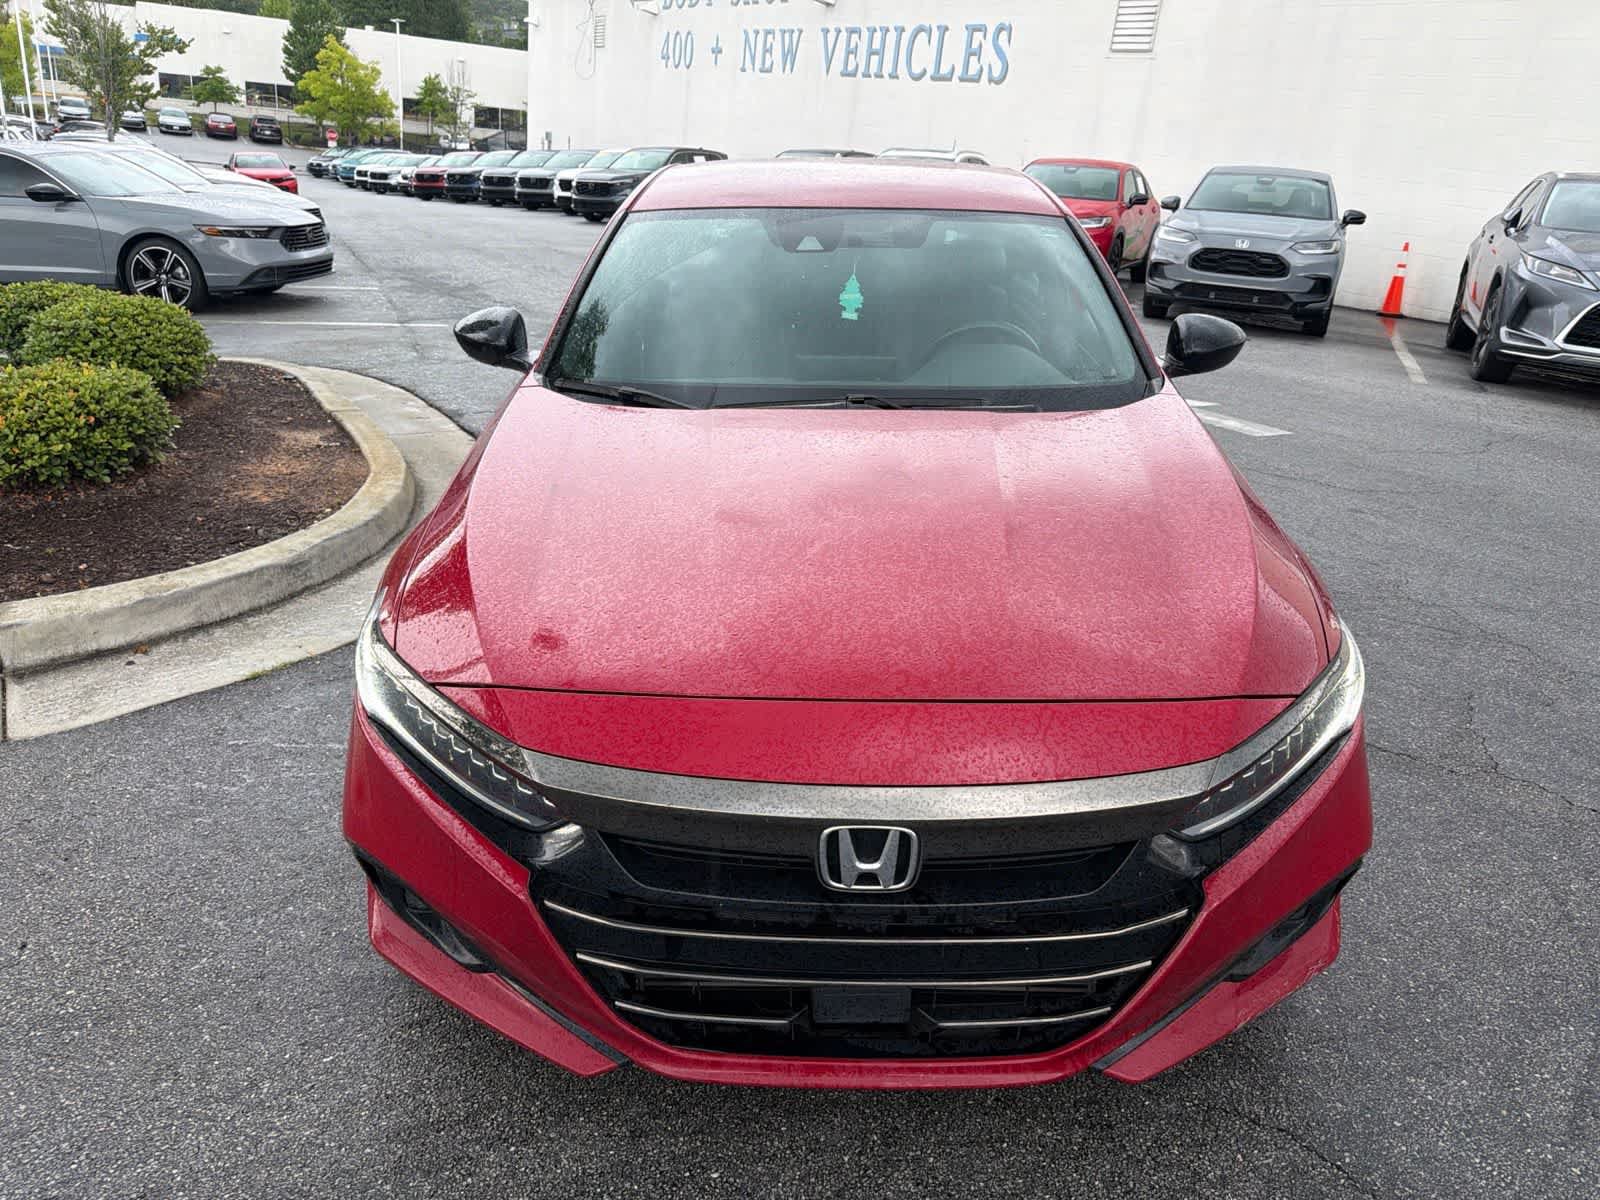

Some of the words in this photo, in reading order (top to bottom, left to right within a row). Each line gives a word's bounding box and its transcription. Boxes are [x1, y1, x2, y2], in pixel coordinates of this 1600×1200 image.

[660, 30, 695, 70] 400
[710, 33, 724, 67] +
[739, 28, 805, 75] NEW
[820, 21, 1013, 85] VEHICLES
